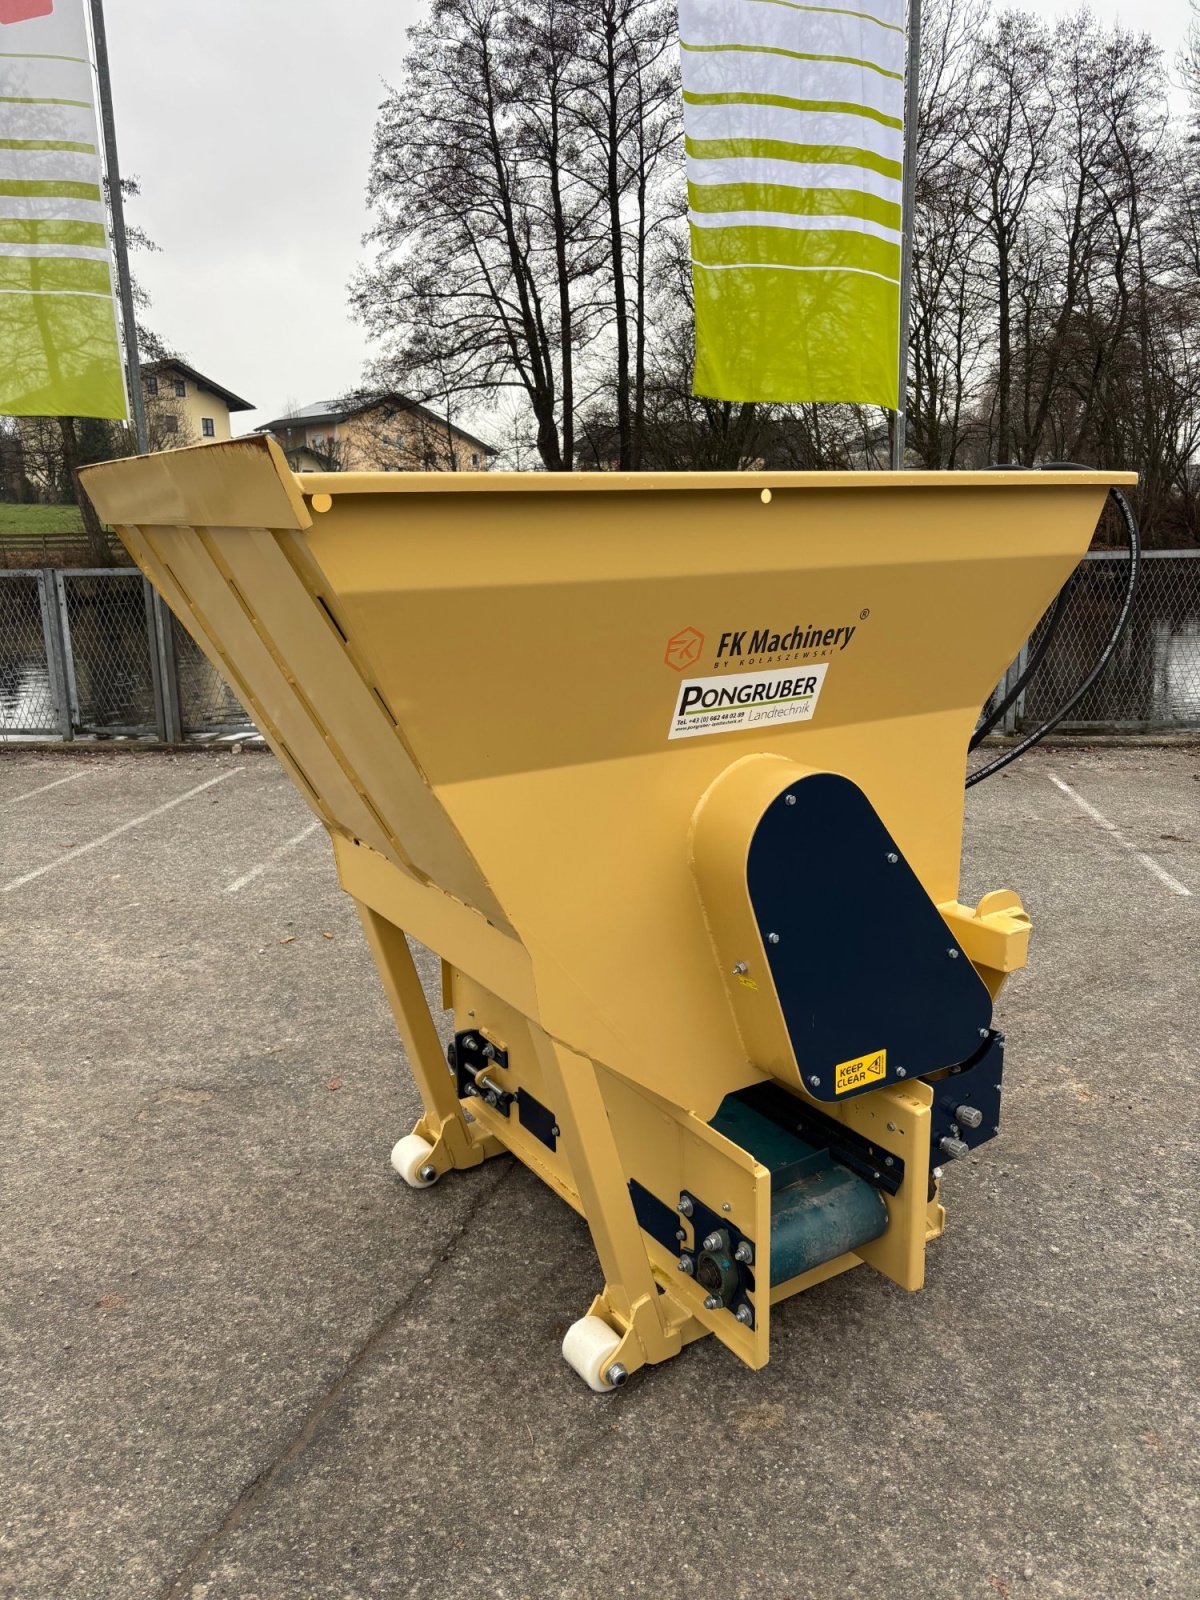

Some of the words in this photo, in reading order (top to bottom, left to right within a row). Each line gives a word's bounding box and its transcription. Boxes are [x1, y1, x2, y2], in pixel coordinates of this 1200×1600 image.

[716, 630, 748, 658] FK
[747, 624, 856, 655] Machinery
[713, 661, 729, 669] BY
[678, 676, 817, 716] PONGRUBER
[748, 701, 810, 722] Landtechnik
[840, 1062, 864, 1078] KEEP
[837, 1071, 866, 1089] CLEAR
